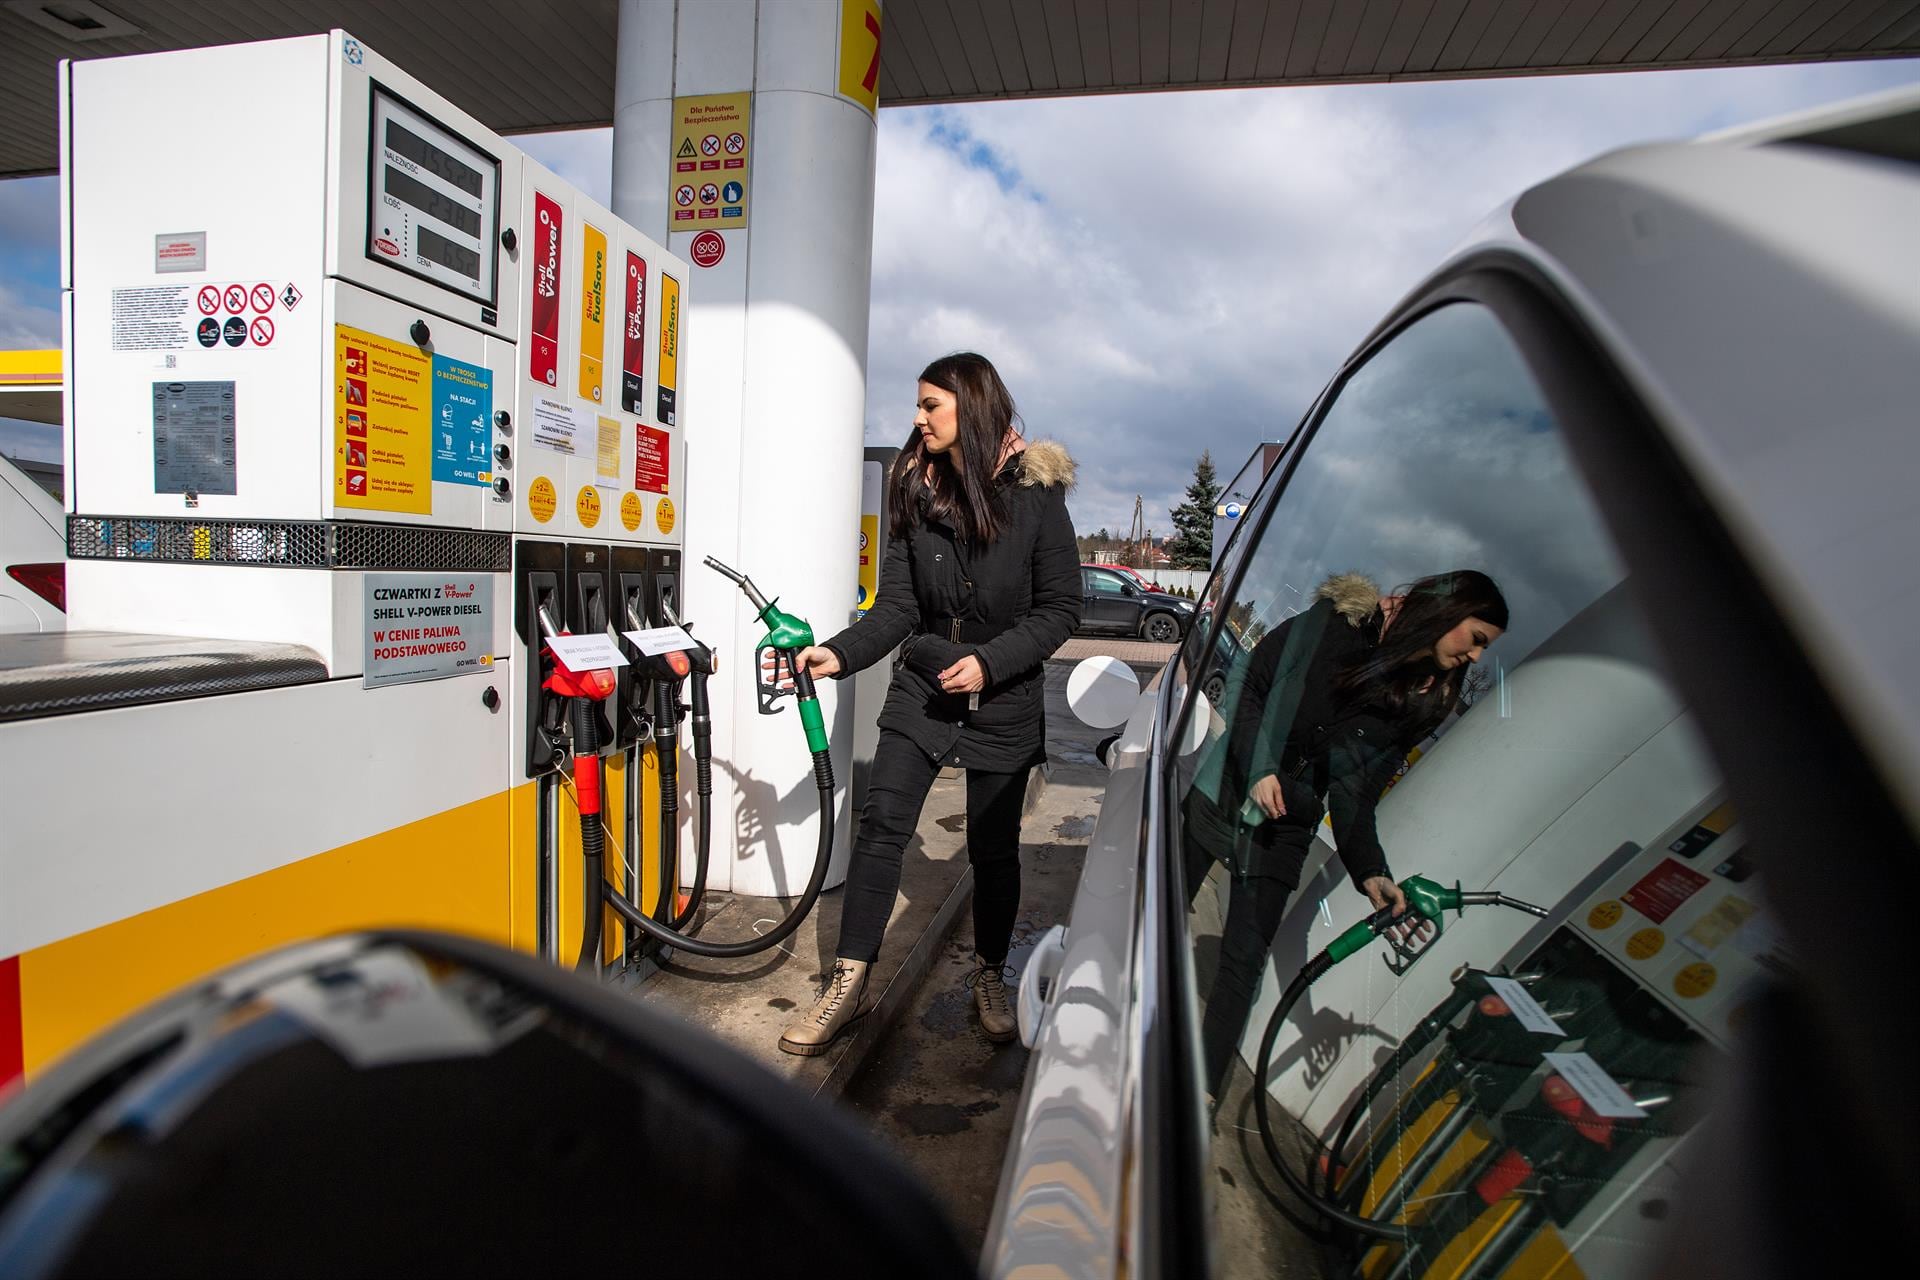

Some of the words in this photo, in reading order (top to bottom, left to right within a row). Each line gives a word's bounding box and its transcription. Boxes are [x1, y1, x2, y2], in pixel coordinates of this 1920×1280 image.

[861, 9, 880, 94] 7
[690, 106, 702, 114] Dla
[704, 104, 735, 113] Państwa
[684, 114, 740, 125] Bezpieczeństwa
[417, 256, 432, 268] CENA
[545, 220, 558, 298] V-Power
[592, 250, 604, 324] FuelSave
[633, 273, 644, 341] V-Power
[668, 294, 677, 359] FuelSave
[541, 345, 548, 356] 95
[339, 385, 343, 393] 2
[450, 393, 459, 402] NA
[338, 416, 343, 424] 3
[338, 447, 343, 455] 4
[454, 470, 462, 478] GO
[463, 471, 475, 479] WELL
[338, 477, 343, 486] 5
[580, 499, 589, 510] +1
[374, 588, 431, 601] CZWARTKI
[434, 588, 441, 599] Z
[445, 590, 472, 599] V-Power
[373, 608, 404, 620] SHELL
[407, 606, 451, 618] V-POWER
[454, 605, 482, 616] DIESEL
[373, 631, 385, 643] W
[388, 629, 420, 642] CENIE
[423, 626, 461, 639] PALIWA
[374, 641, 467, 660] PODSTAWOWEGO
